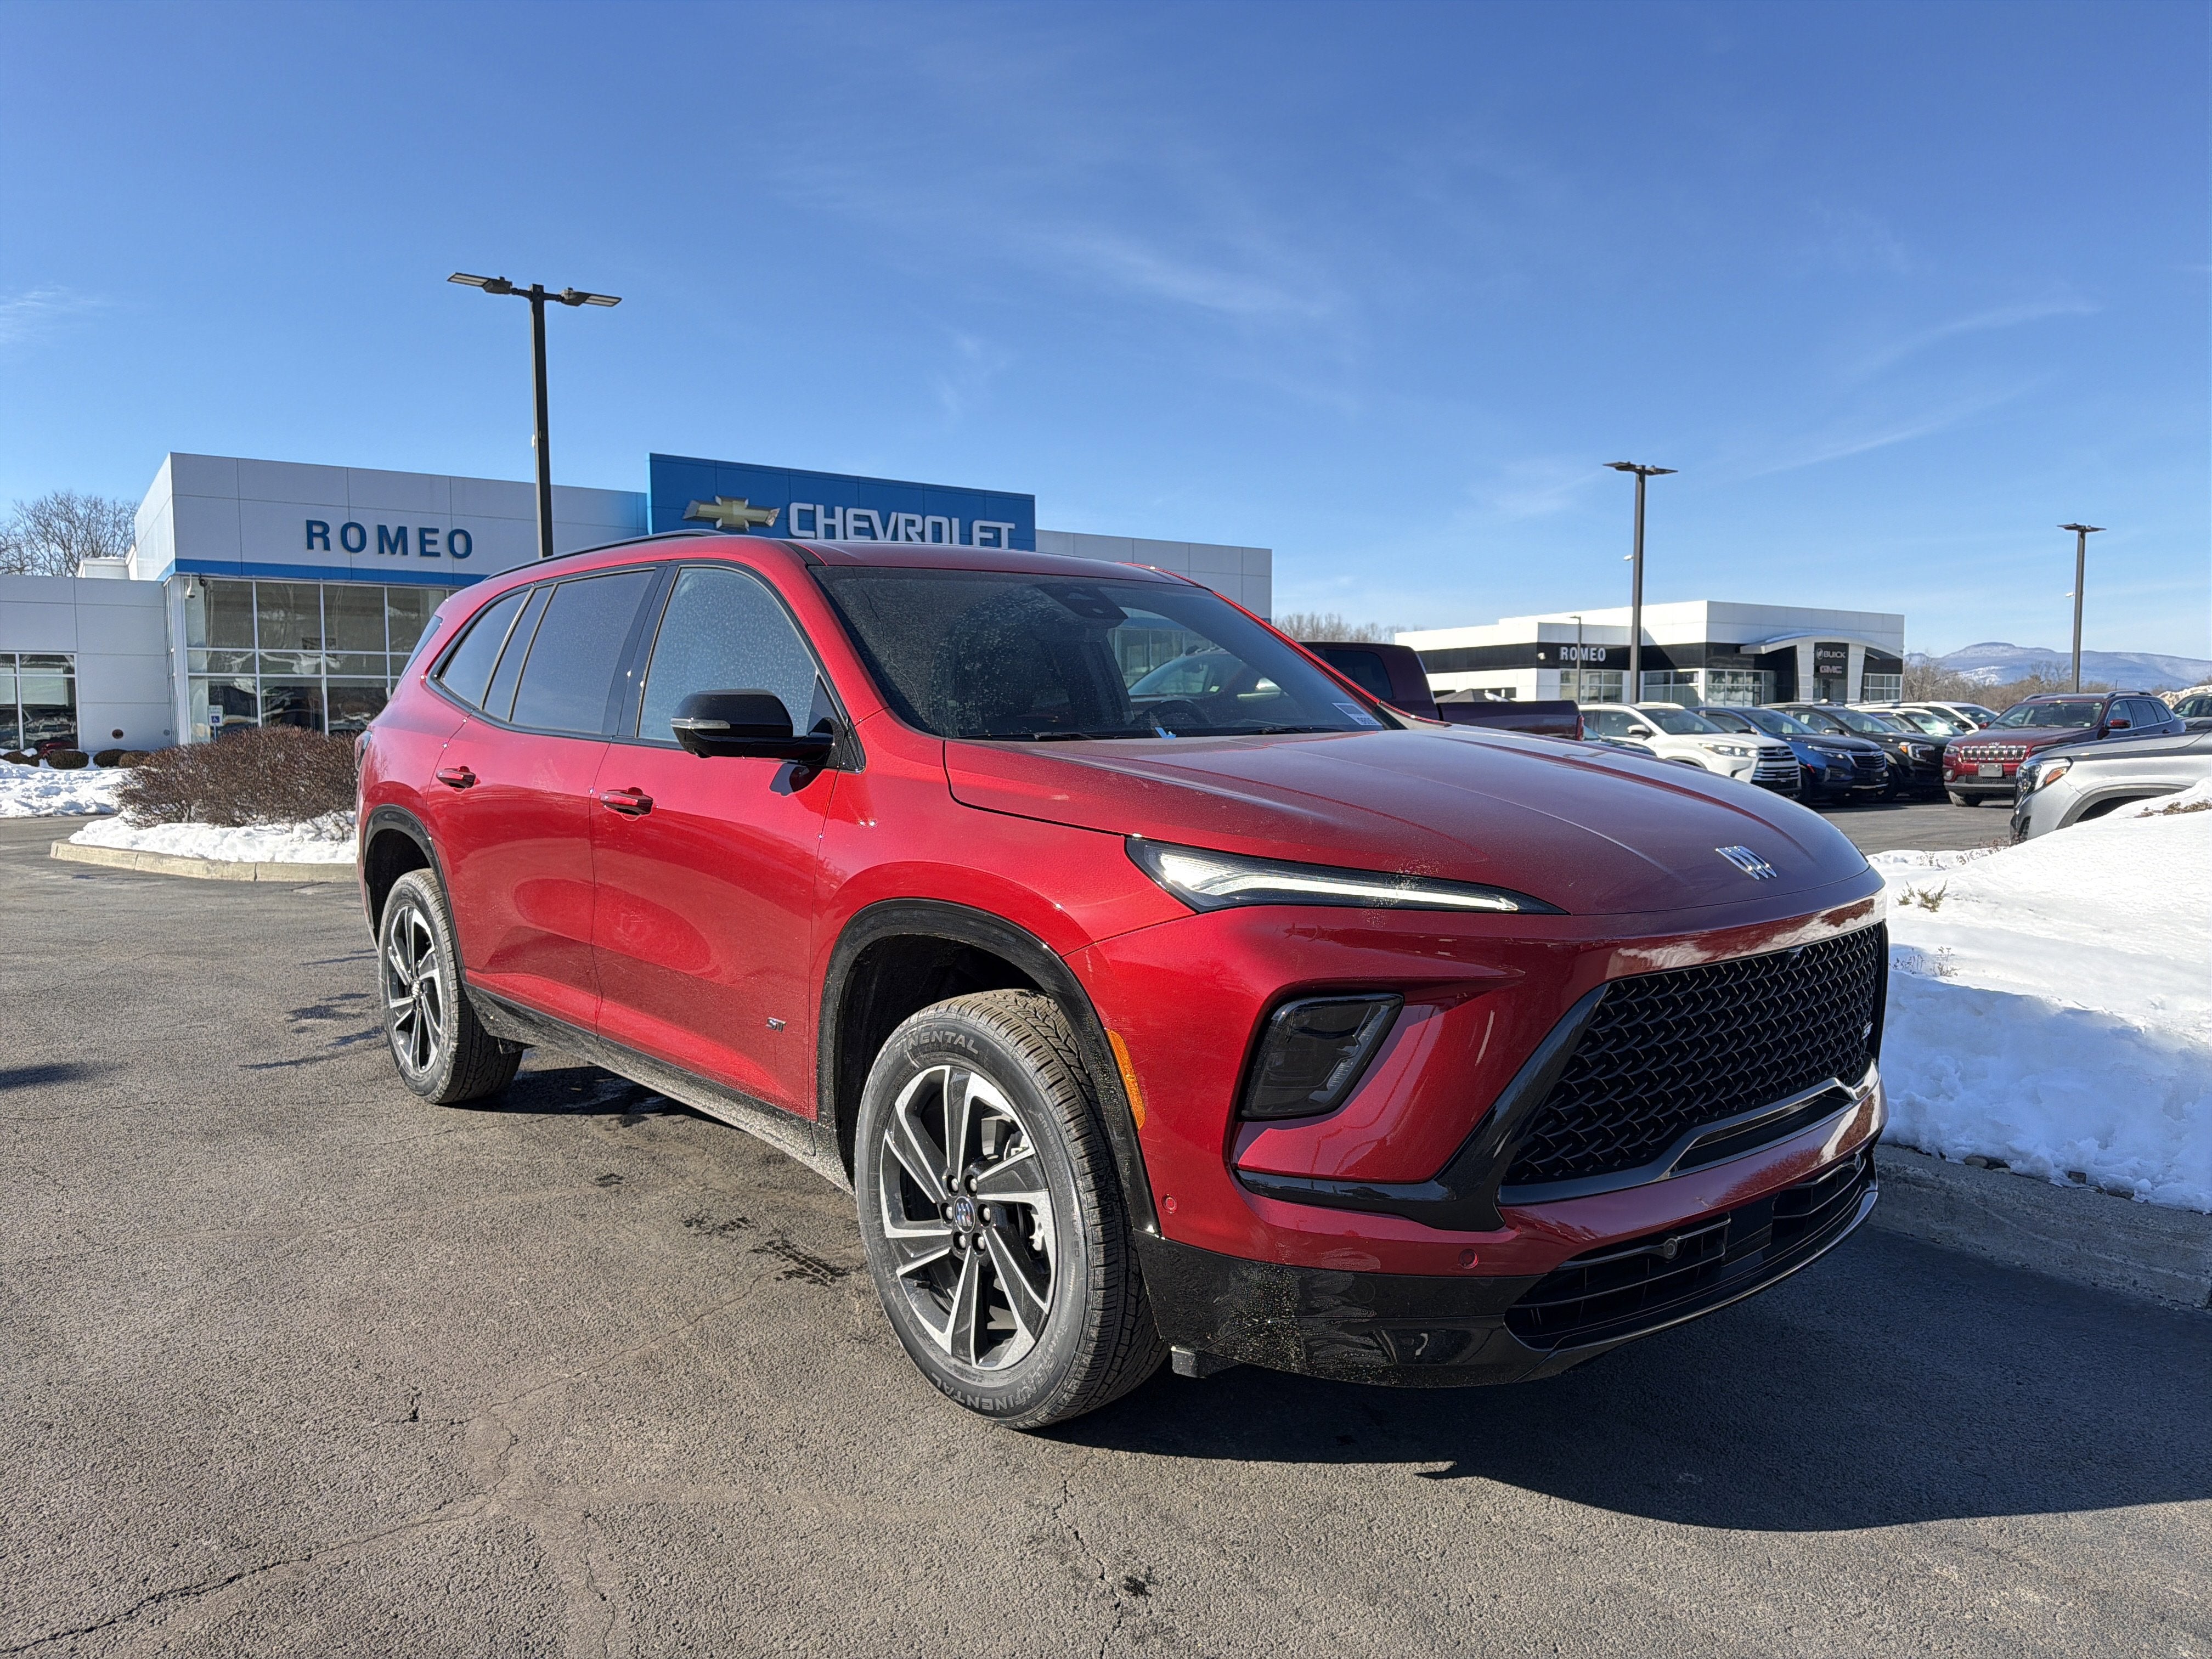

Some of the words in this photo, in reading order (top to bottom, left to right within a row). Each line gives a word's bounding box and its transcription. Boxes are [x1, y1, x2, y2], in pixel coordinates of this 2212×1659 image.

[789, 502, 1015, 549] CHEVROLET
[306, 520, 472, 559] ROMEO
[1560, 647, 1606, 662] ROMEO
[1820, 665, 1842, 674] GMC
[765, 1017, 787, 1032] ST
